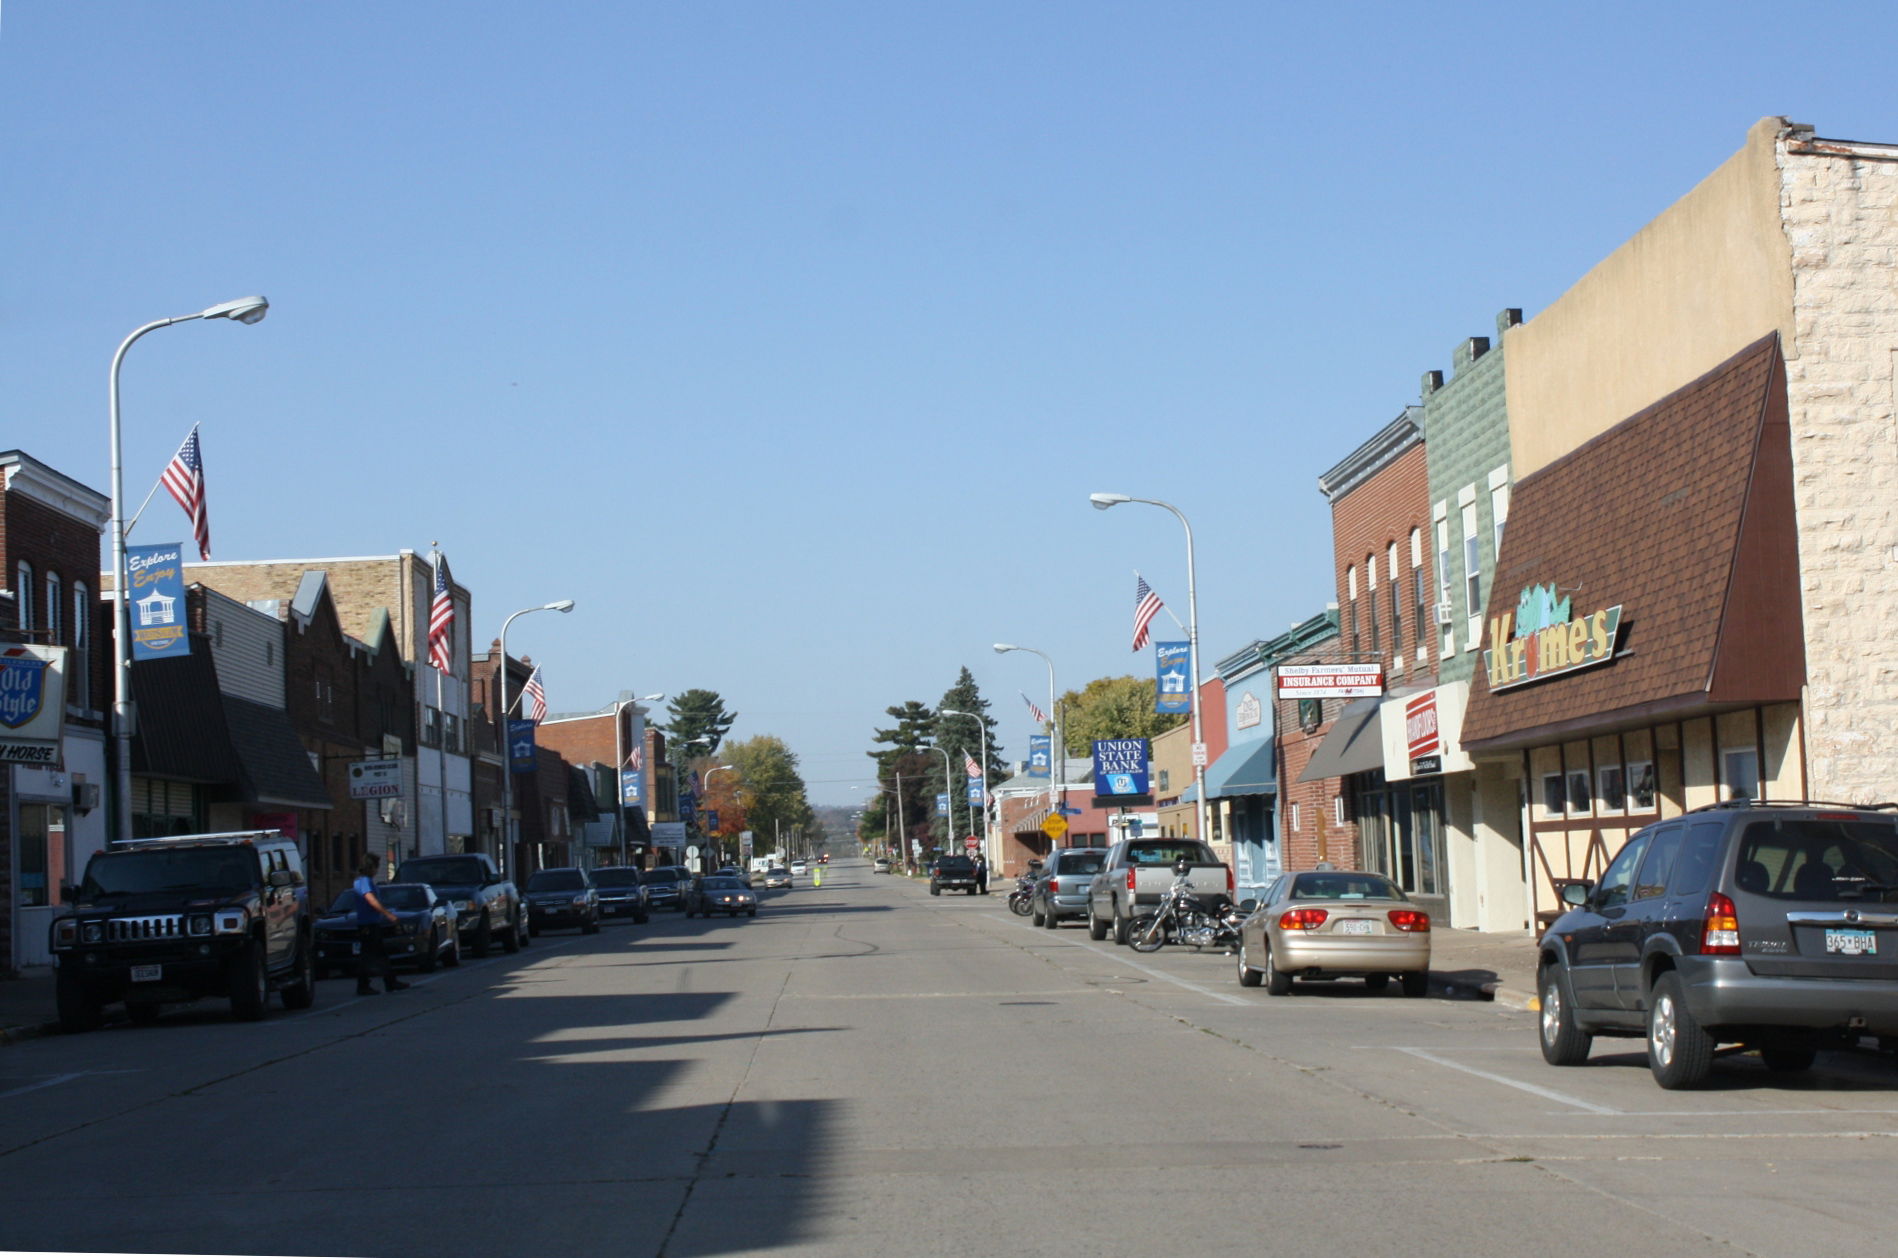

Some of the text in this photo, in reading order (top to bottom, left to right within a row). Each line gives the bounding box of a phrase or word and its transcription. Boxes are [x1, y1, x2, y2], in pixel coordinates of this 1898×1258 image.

[129, 552, 178, 571] Explore
[133, 567, 176, 587] Enjoy
[1284, 667, 1309, 676] Shelby
[1347, 665, 1374, 673] Mutual
[1, 668, 33, 691] Old
[1283, 675, 1378, 687] INSURANCE COMPANY
[1097, 740, 1142, 752] UNION
[7, 744, 54, 761] HORSE
[1099, 750, 1142, 761] STATE
[1102, 760, 1140, 771] BANK
[352, 783, 399, 796] LEGION
